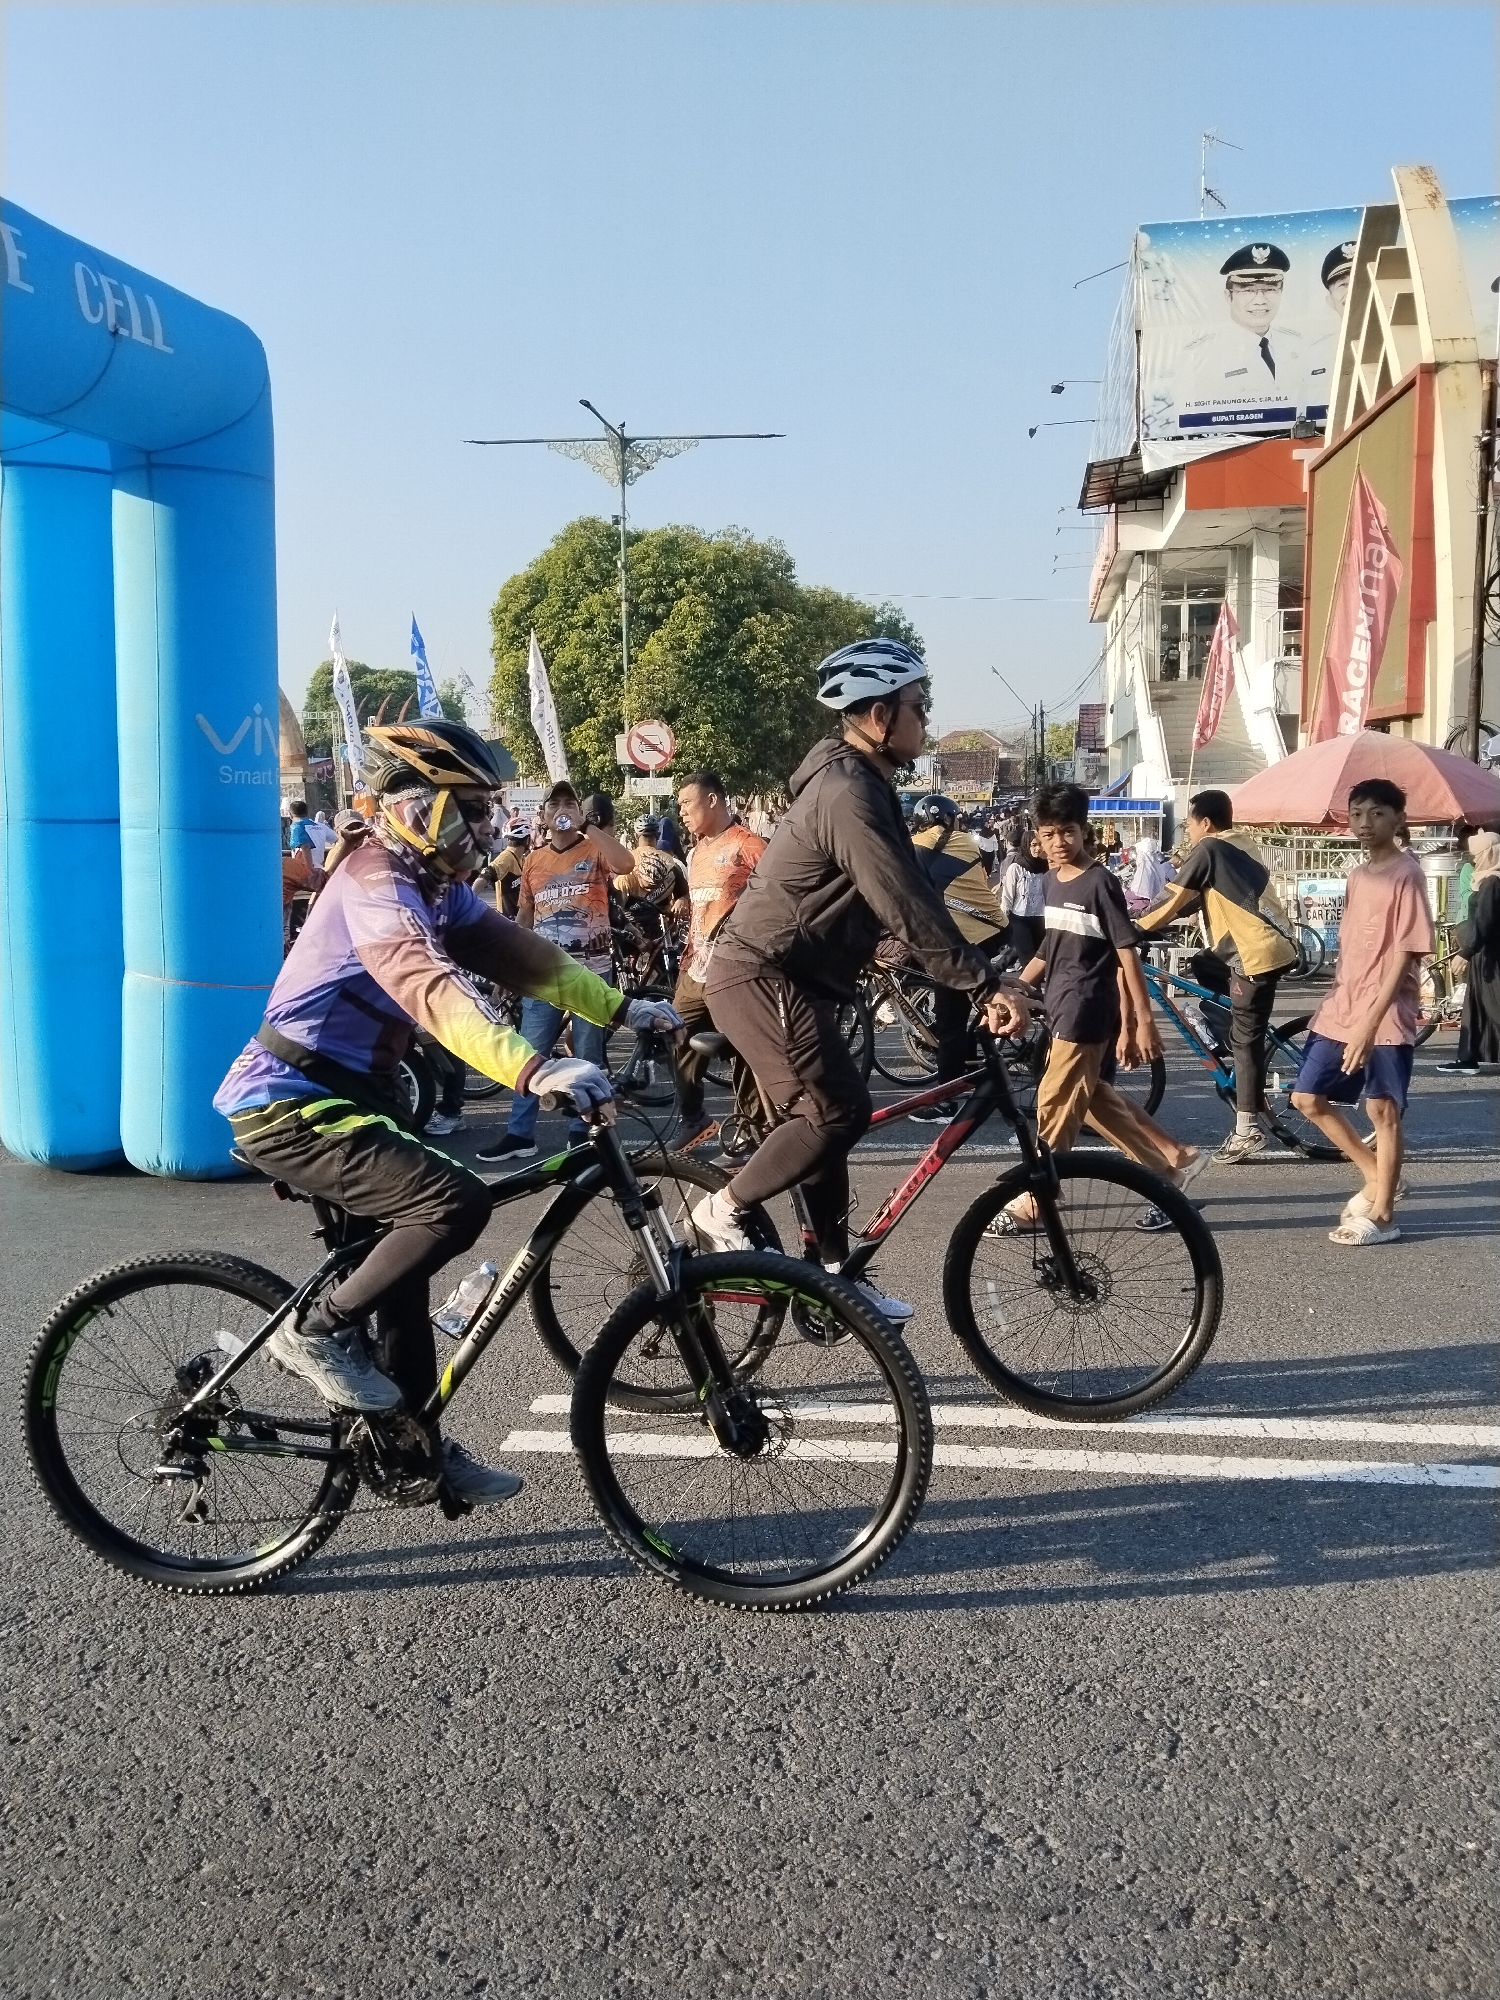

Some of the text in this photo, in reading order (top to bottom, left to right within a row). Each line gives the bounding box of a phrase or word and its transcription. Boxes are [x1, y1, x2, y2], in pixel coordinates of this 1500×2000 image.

[74, 261, 174, 354] CELL
[1211, 412, 1264, 422] BUPATI SRAGEN
[219, 765, 272, 785] Smart
[1306, 908, 1343, 921] CAR FRE
[471, 1252, 536, 1344] POLYGON
